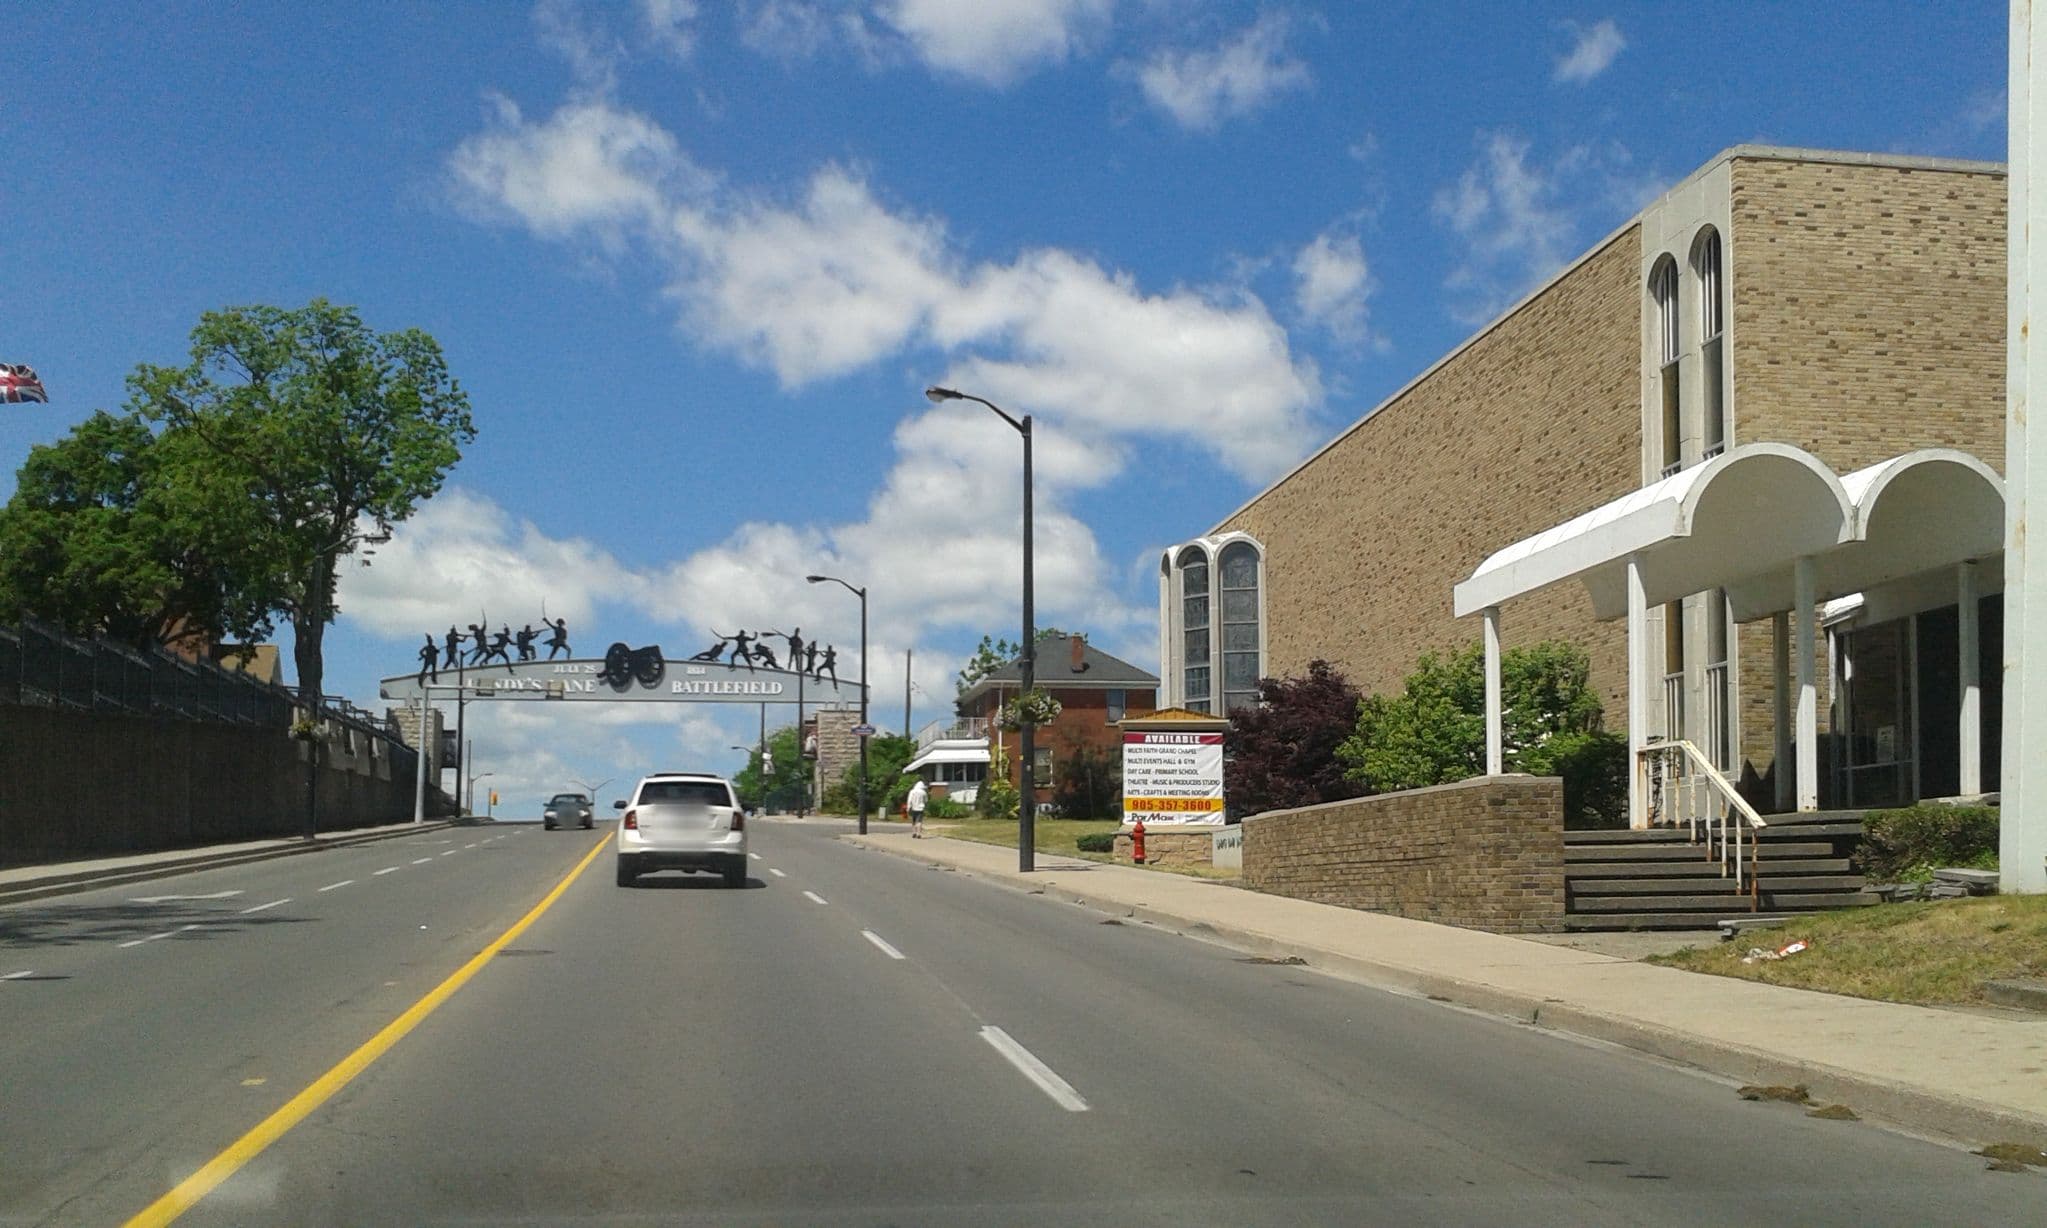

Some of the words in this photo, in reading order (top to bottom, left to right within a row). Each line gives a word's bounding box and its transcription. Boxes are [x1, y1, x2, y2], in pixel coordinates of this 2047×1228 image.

[464, 678, 542, 690] LNDY'S
[547, 679, 596, 692] ANE
[671, 680, 783, 695] BATTLEFIELD
[1144, 734, 1201, 744] AVAILABLE
[1132, 800, 1212, 811] 905-357-3600
